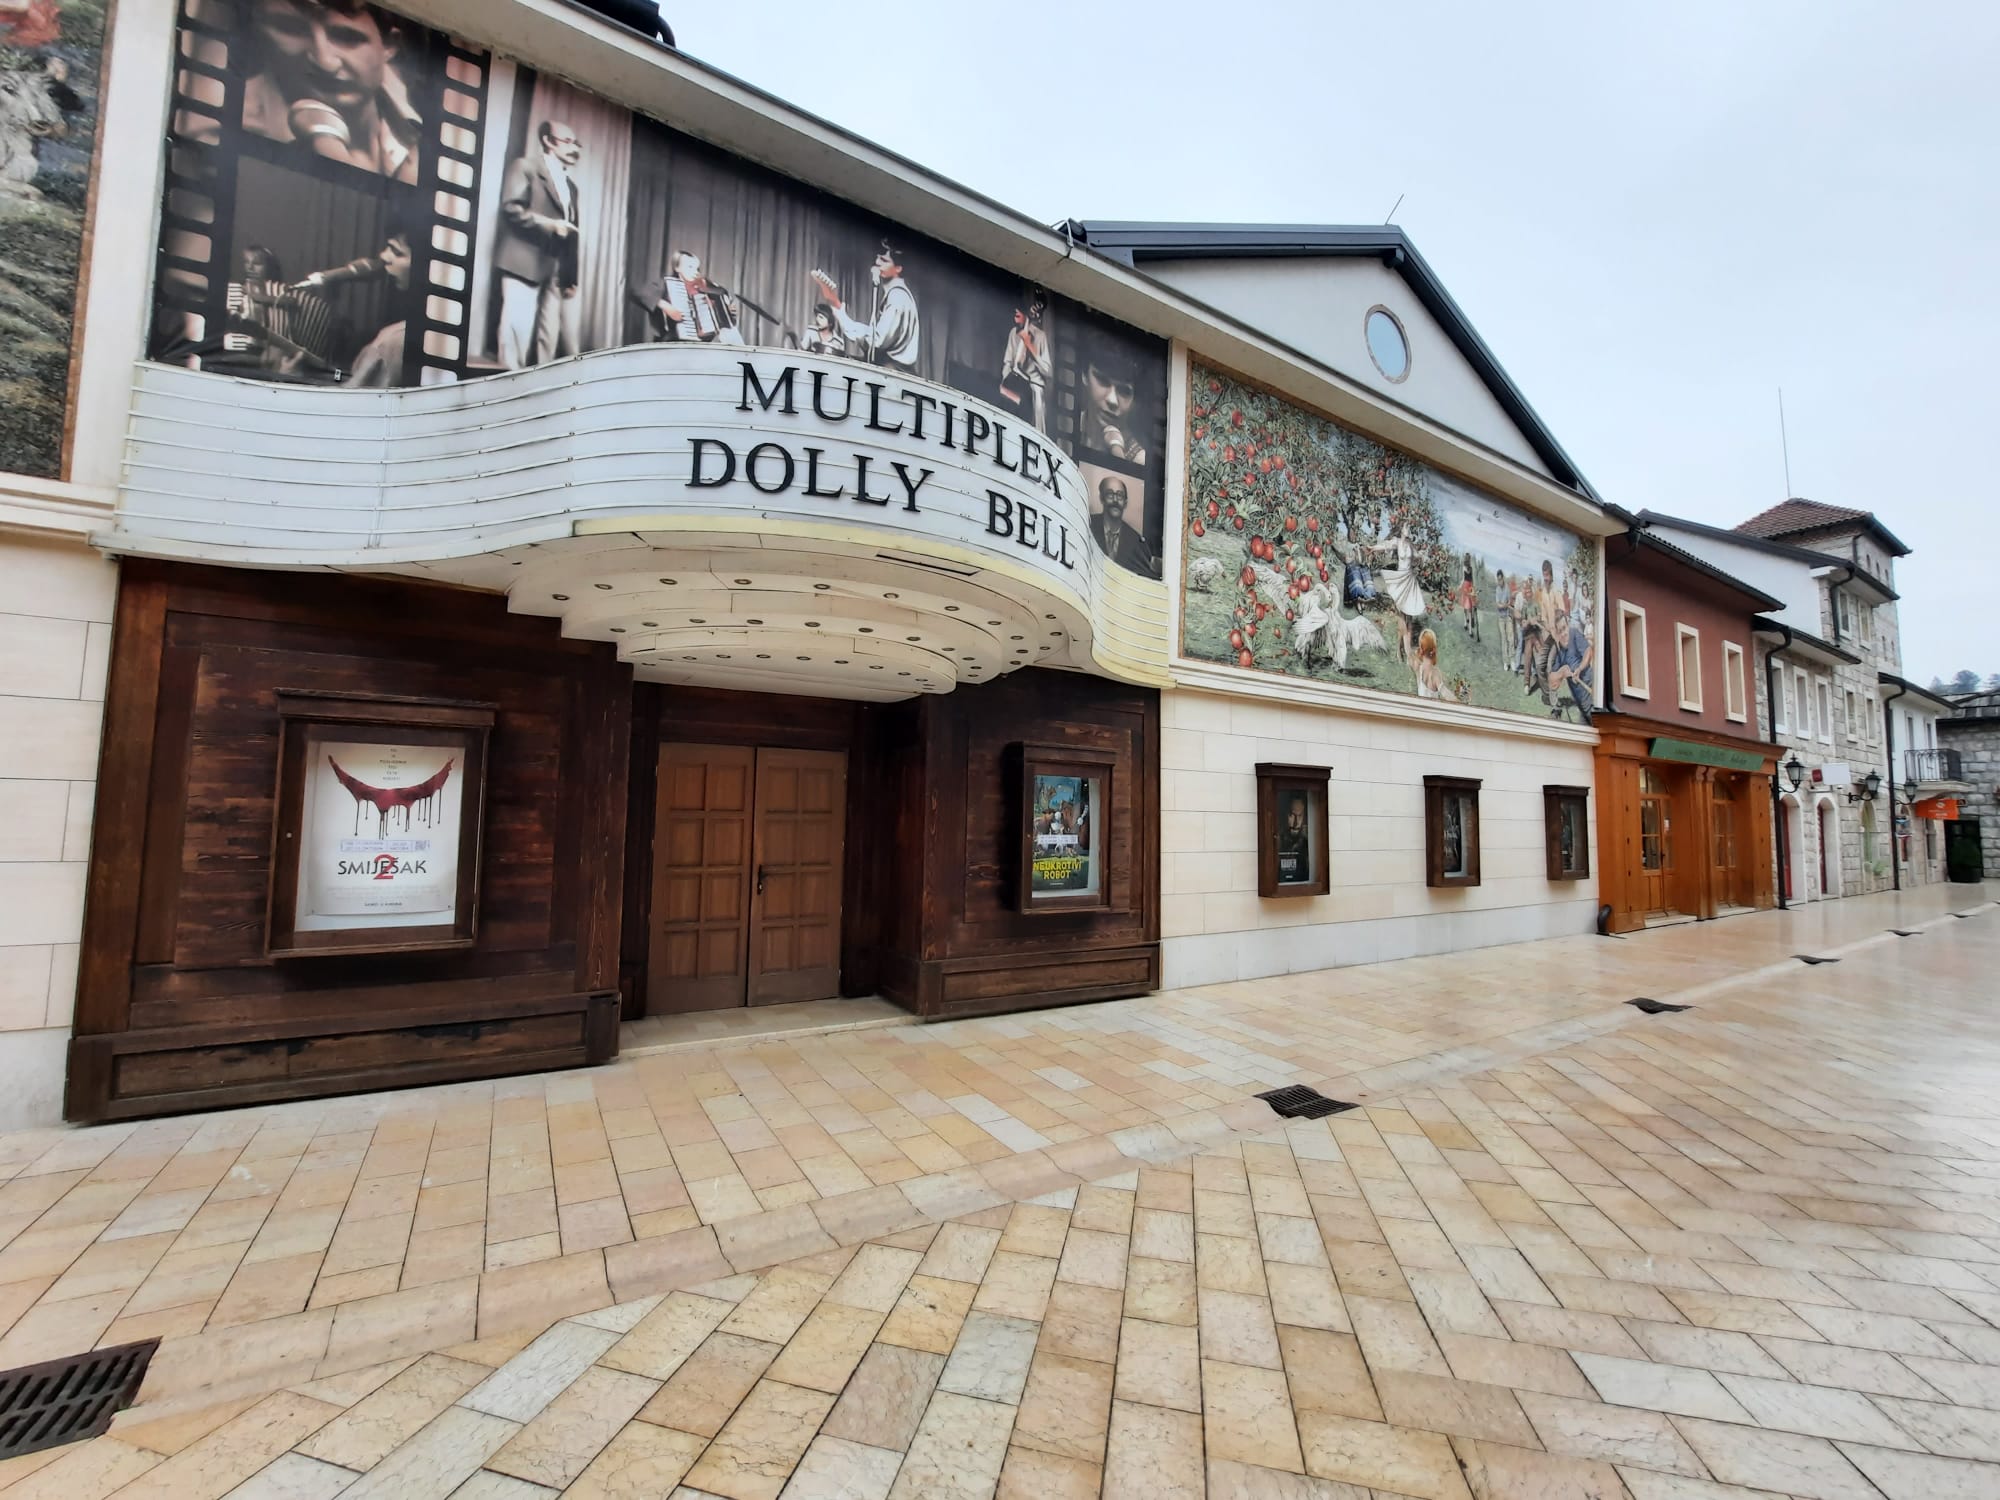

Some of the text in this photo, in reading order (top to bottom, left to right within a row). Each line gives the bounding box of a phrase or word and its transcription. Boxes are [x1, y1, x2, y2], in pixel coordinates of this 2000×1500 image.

[735, 361, 1064, 500] MULTIPLEX
[684, 438, 1075, 570] DOLLY BELL
[337, 857, 427, 875] SMIJEŠAK
[373, 854, 394, 880] 2
[1043, 870, 1071, 880] ROBOT
